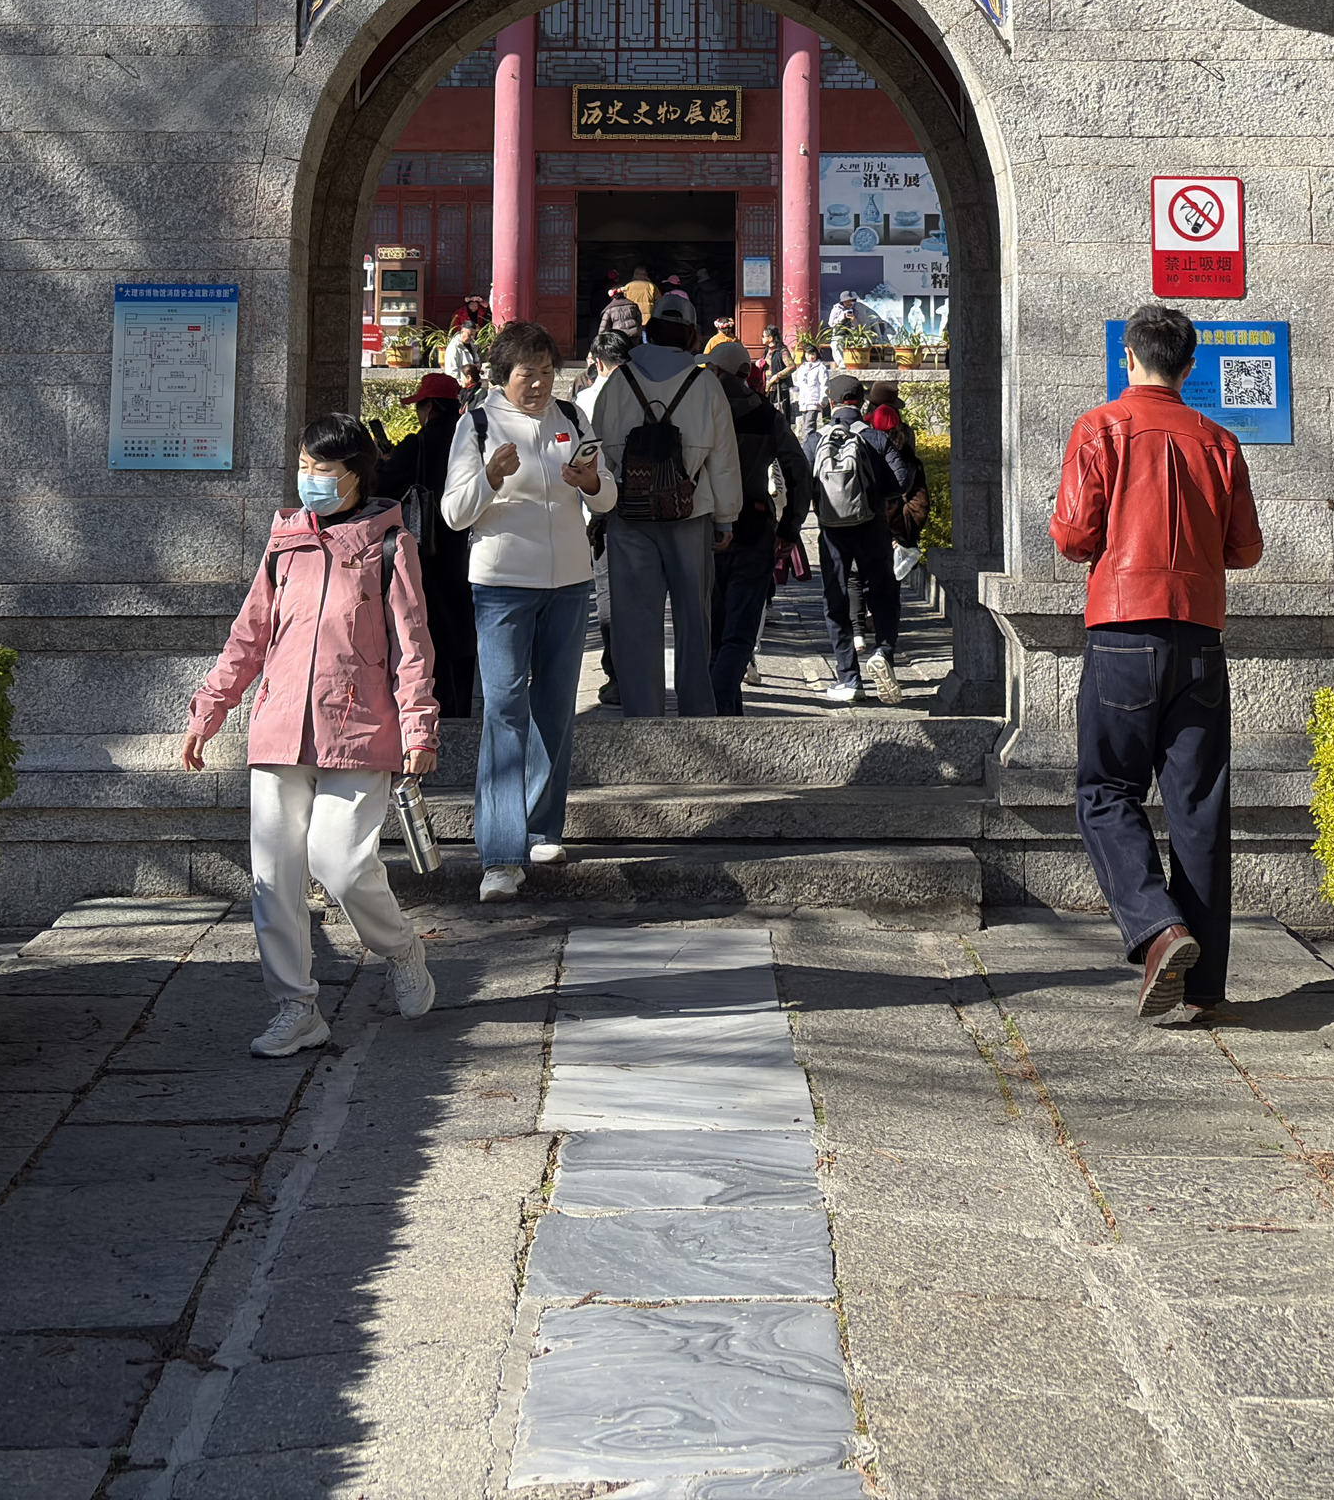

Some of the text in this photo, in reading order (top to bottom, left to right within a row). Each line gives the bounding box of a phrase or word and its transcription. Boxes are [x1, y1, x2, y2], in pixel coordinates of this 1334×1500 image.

[862, 172, 921, 188] 沿革展
[1164, 255, 1232, 271] 禁止吸烟
[1166, 274, 1232, 283] NO SMOKING
